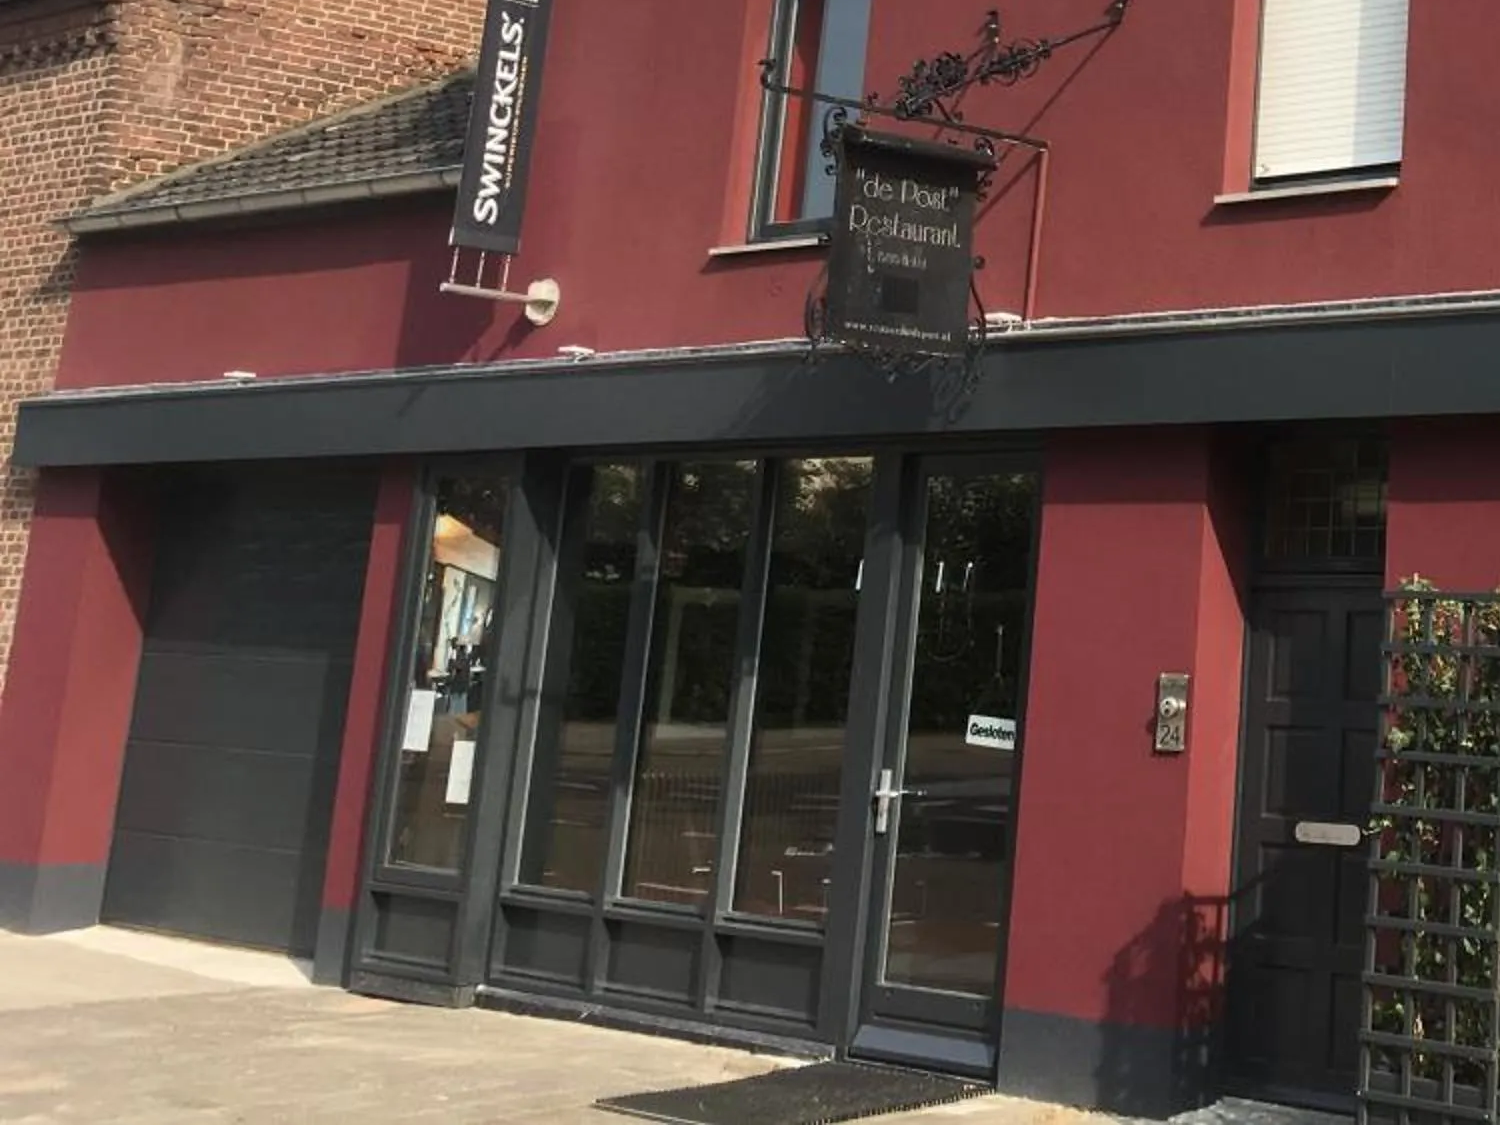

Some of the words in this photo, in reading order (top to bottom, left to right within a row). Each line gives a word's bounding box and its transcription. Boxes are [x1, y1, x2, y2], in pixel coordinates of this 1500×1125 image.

[849, 204, 961, 248] Restaurant
[970, 722, 1015, 741] Gesloten
[1159, 724, 1180, 746] 24
